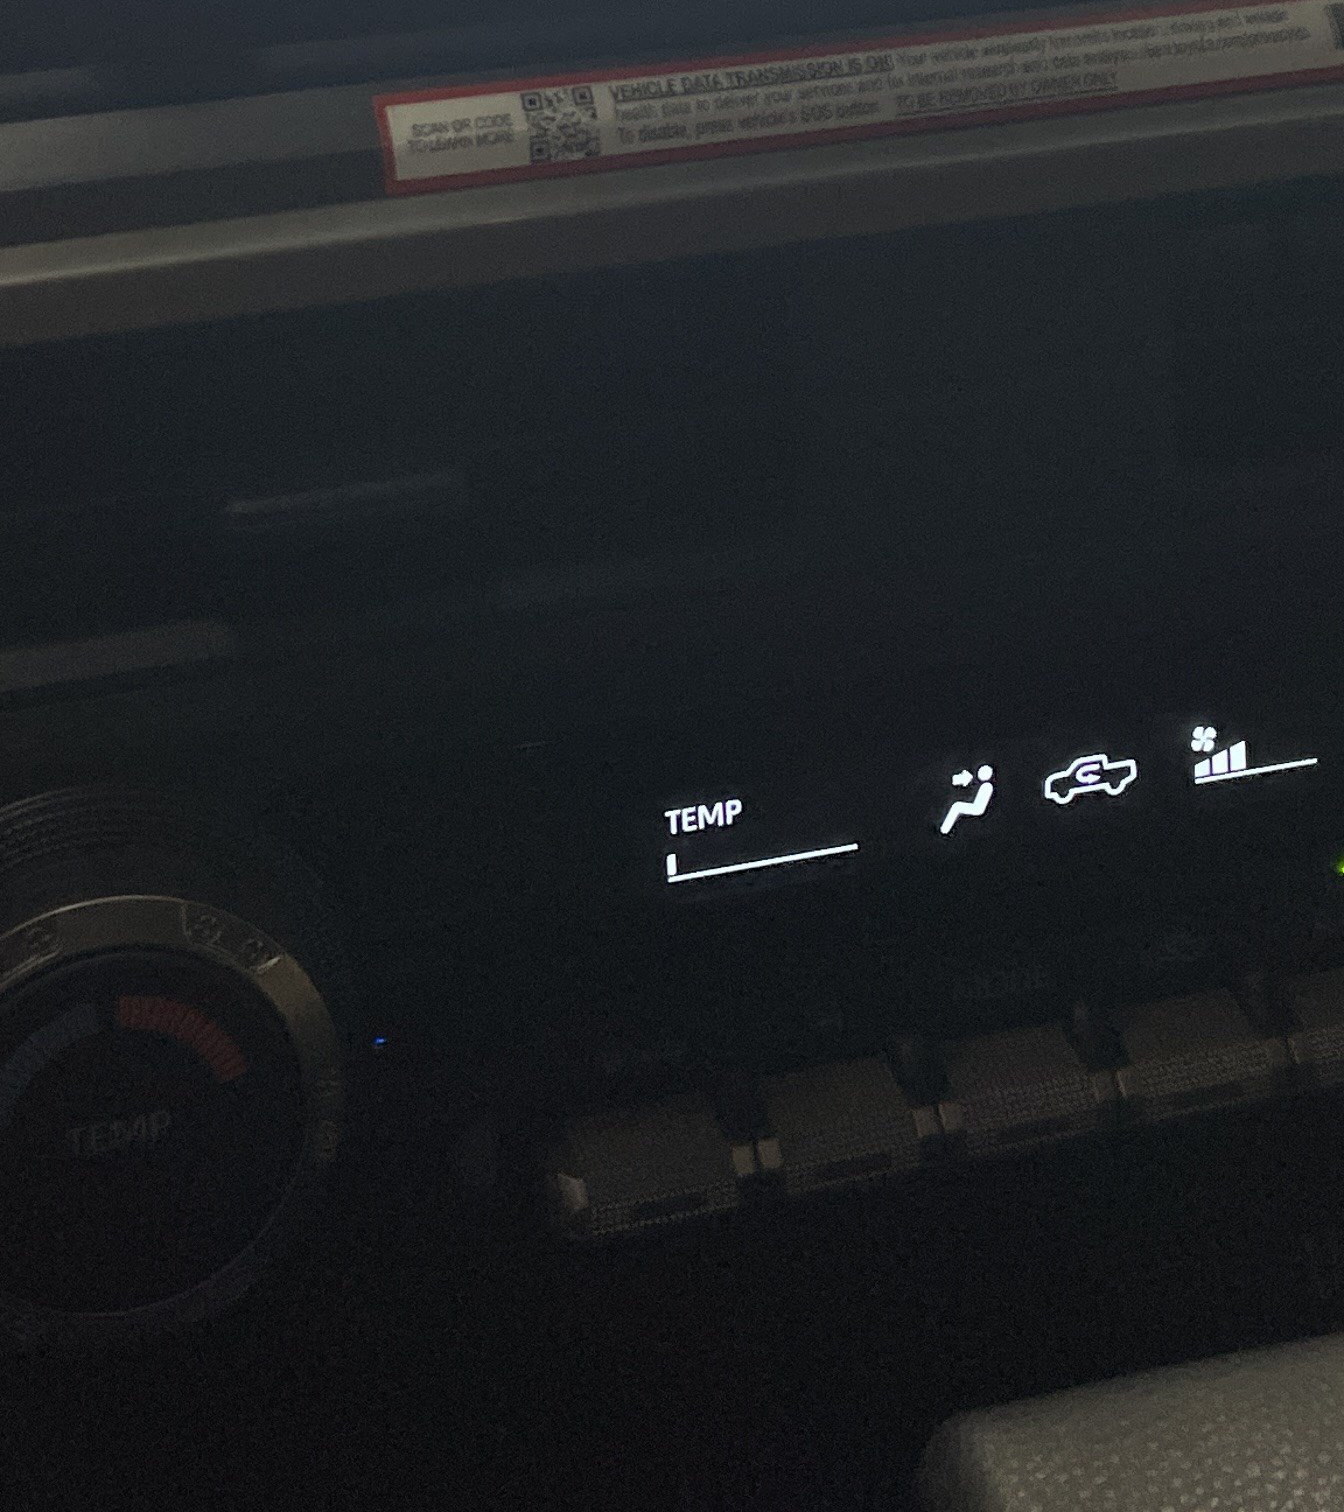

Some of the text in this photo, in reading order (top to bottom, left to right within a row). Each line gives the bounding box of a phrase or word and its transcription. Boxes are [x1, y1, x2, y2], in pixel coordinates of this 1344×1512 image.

[610, 78, 678, 100] VEHICLE
[680, 73, 723, 92] DATA
[724, 59, 844, 87] TRANSMISSION
[664, 798, 744, 836] TEMP
